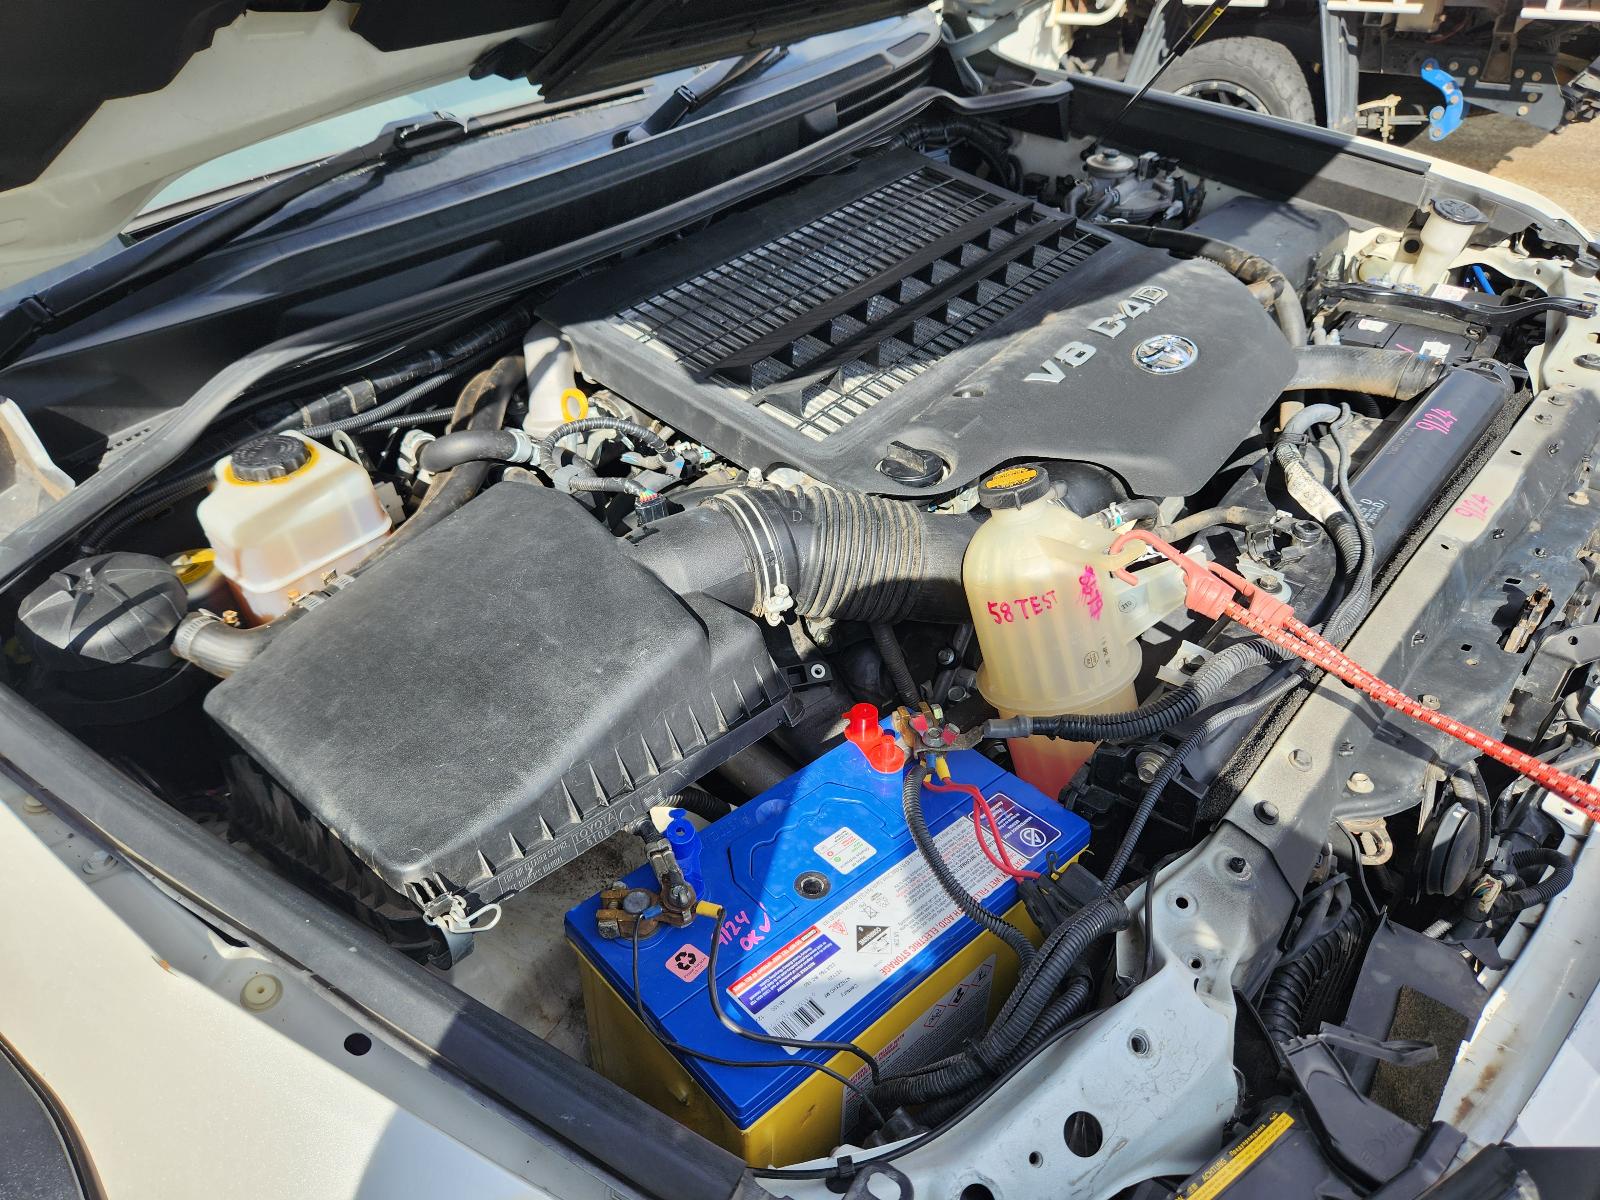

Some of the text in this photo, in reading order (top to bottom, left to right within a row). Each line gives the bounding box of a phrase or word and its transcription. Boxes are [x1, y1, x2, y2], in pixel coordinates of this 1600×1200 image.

[1023, 341, 1097, 384] V8
[987, 600, 1015, 624] 58
[1014, 590, 1058, 620] TEST
[574, 812, 615, 842] TOYOTA
[935, 912, 955, 930] ACID,
[739, 930, 765, 951] OK
[911, 926, 938, 951] ELECTRIC
[879, 949, 912, 976] STORAGE
[1202, 1158, 1227, 1181] ACHTUNG
